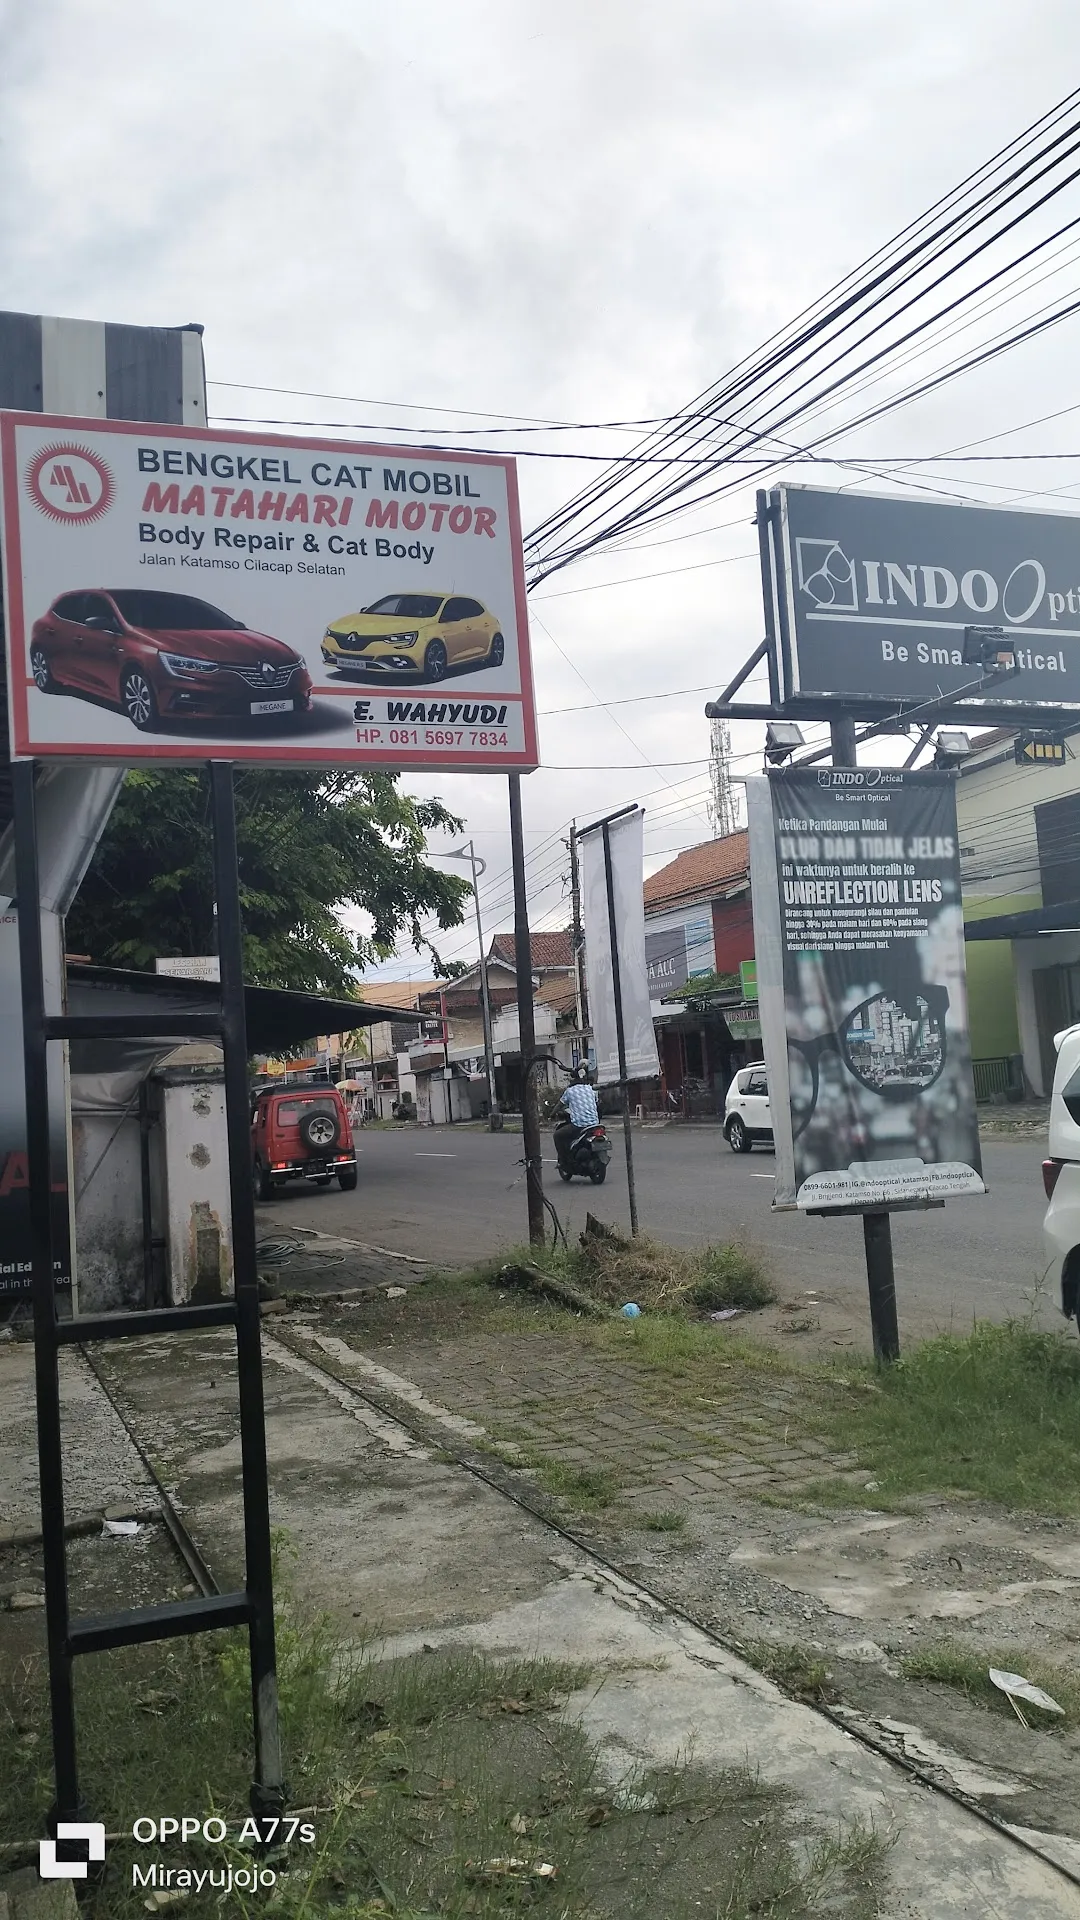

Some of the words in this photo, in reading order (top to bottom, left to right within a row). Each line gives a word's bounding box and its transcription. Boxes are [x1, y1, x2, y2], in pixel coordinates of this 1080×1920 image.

[137, 448, 301, 484] BENGKEL
[311, 463, 372, 489] CAT
[383, 468, 481, 498] MOBIL
[142, 482, 354, 527] MATAHARI
[365, 499, 497, 538] MOTOR
[138, 523, 205, 550] Body
[214, 527, 295, 553] Repair
[302, 533, 320, 553] &
[328, 535, 367, 556] Cat
[375, 538, 435, 564] Body
[139, 553, 176, 566] Jalan
[180, 555, 240, 570] Katamso
[244, 559, 293, 575] Cilacap
[297, 562, 346, 576] Selatan
[862, 561, 999, 613] INDO
[881, 640, 909, 662] Be
[917, 642, 982, 667] Sma
[259, 702, 287, 711] MEGANE
[353, 701, 374, 721] E.
[387, 701, 508, 724] WAHYUDI
[356, 729, 384, 744] HP.
[389, 730, 418, 745] 081
[425, 731, 464, 746] 5697
[469, 732, 509, 747] 7834
[832, 772, 864, 785] INDO
[866, 768, 903, 787] Optical
[835, 793, 844, 801] Be
[845, 793, 866, 801] Smart
[867, 793, 891, 803] Optical
[779, 818, 807, 831] Ketika
[809, 818, 860, 832] Pandangan
[862, 818, 888, 831] Mulai
[823, 837, 856, 859] DAN
[859, 837, 905, 859] TIDAK
[908, 837, 955, 859] JELAS
[782, 863, 793, 876] ini
[795, 864, 840, 878] waktunya
[842, 863, 869, 876] untuk
[870, 862, 902, 876] beralih
[903, 863, 915, 876] ke
[783, 880, 899, 904] UNREFLECTION
[903, 879, 943, 903] LENS
[814, 908, 831, 917] untuk
[868, 907, 882, 916] silau
[883, 907, 893, 916] dan
[822, 919, 837, 929] pada
[837, 919, 858, 928] malam
[858, 918, 870, 928] hari
[871, 918, 882, 927] dan
[898, 918, 912, 928] pada
[912, 918, 928, 927] siang
[827, 930, 842, 939] Anda
[843, 930, 860, 940] dapat
[786, 942, 804, 951] visual
[817, 941, 834, 951] siang
[834, 941, 855, 951] hingga
[855, 940, 876, 950] malam
[11, 1279, 20, 1289] in
